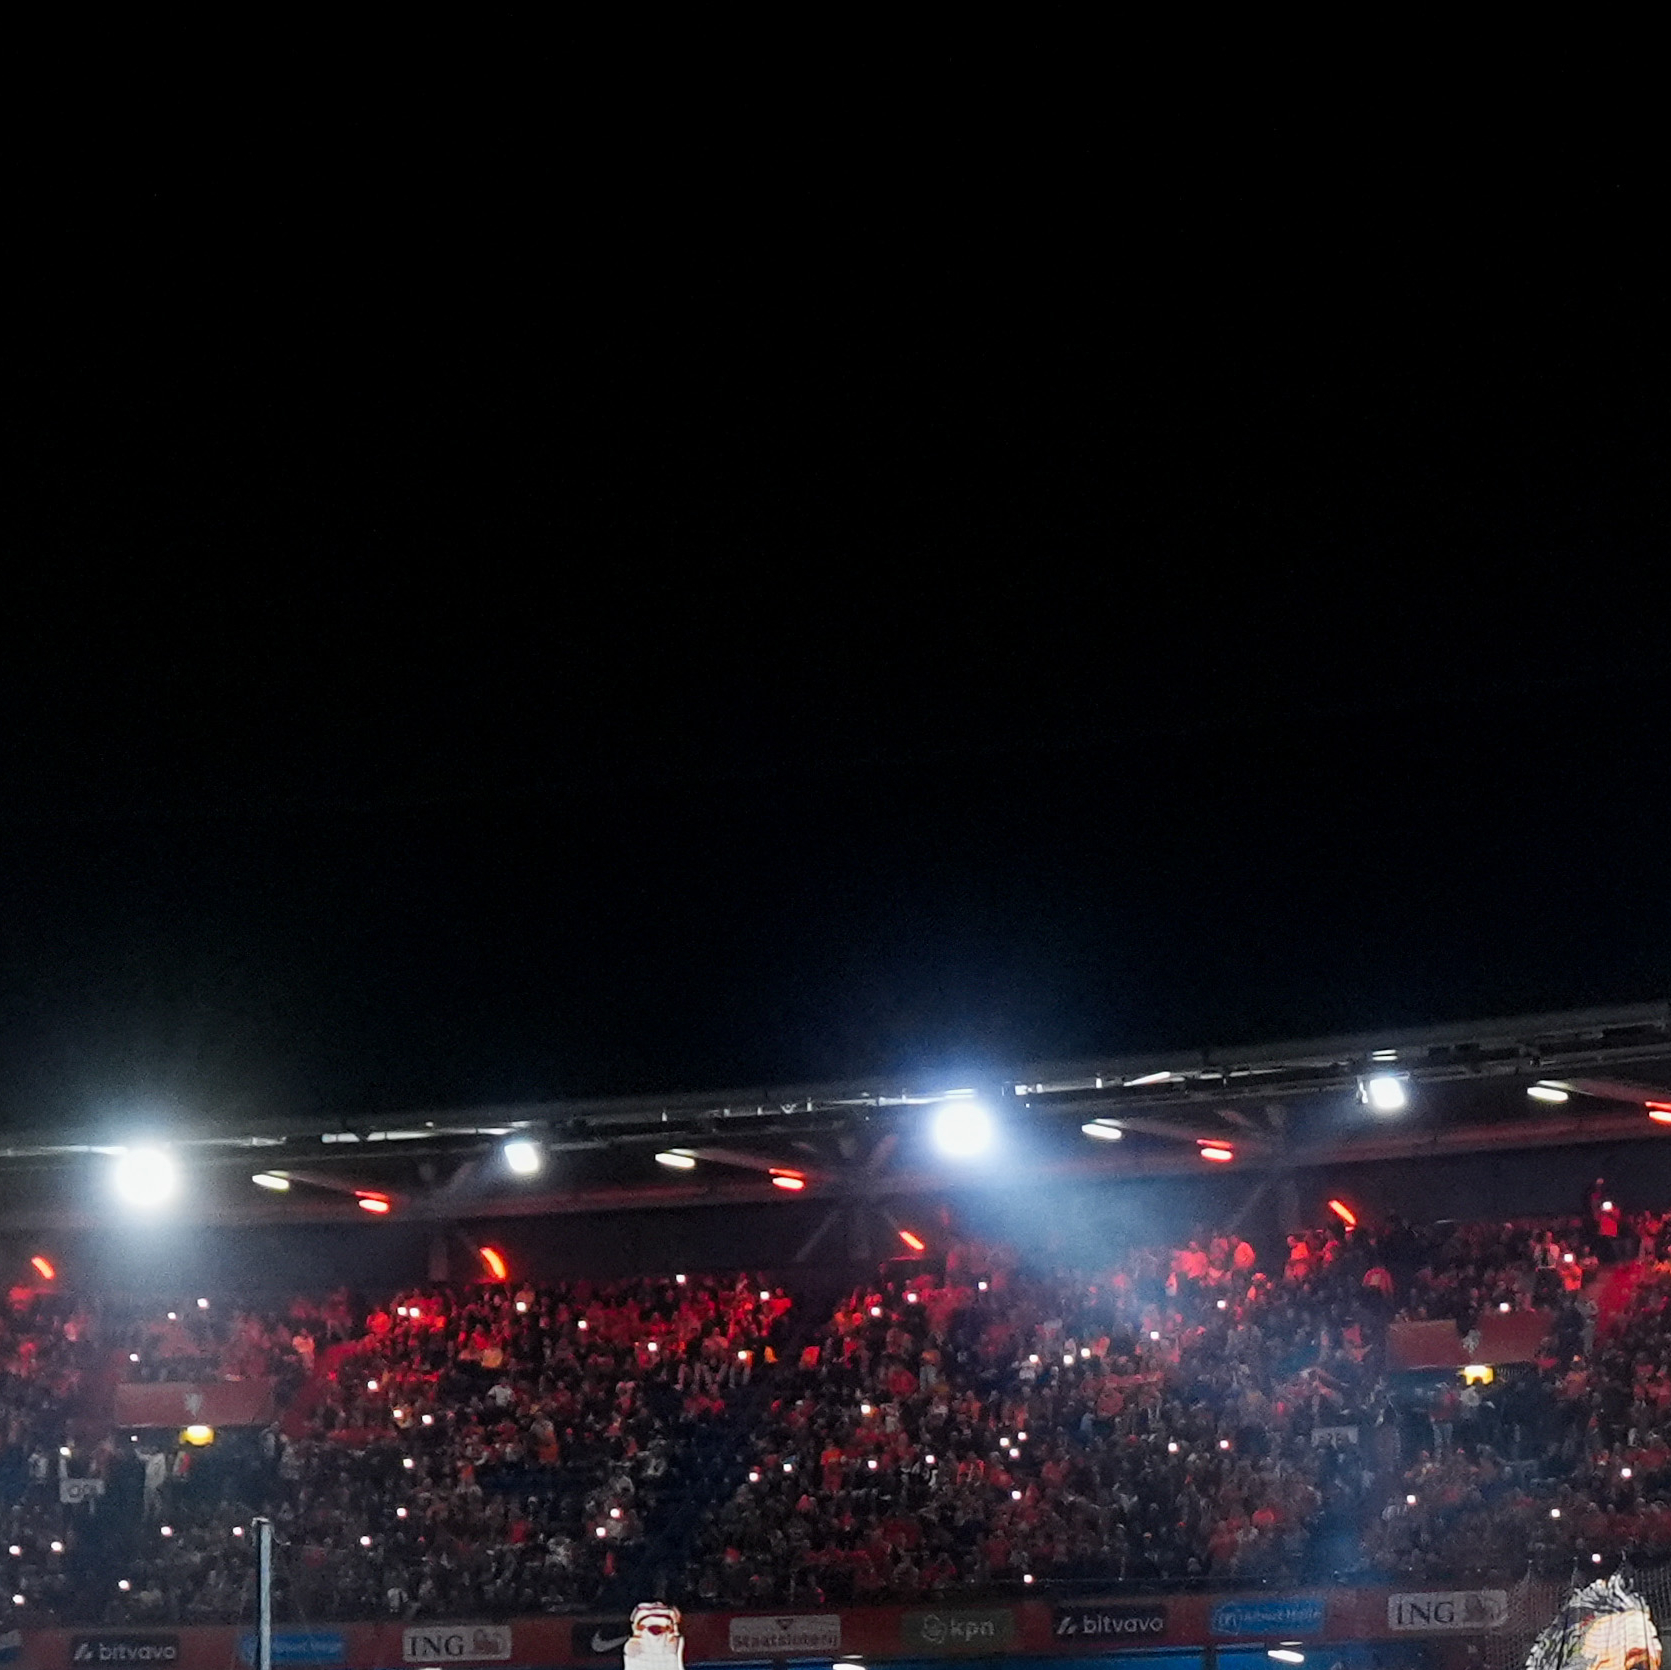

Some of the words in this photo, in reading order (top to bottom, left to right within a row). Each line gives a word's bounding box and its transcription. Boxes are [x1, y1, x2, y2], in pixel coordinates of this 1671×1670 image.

[1082, 1614, 1164, 1634] bitvavo
[1395, 1602, 1456, 1626] ING
[949, 1617, 995, 1641] kpn
[98, 1642, 176, 1660] bitvavo
[409, 1635, 464, 1657] ING
